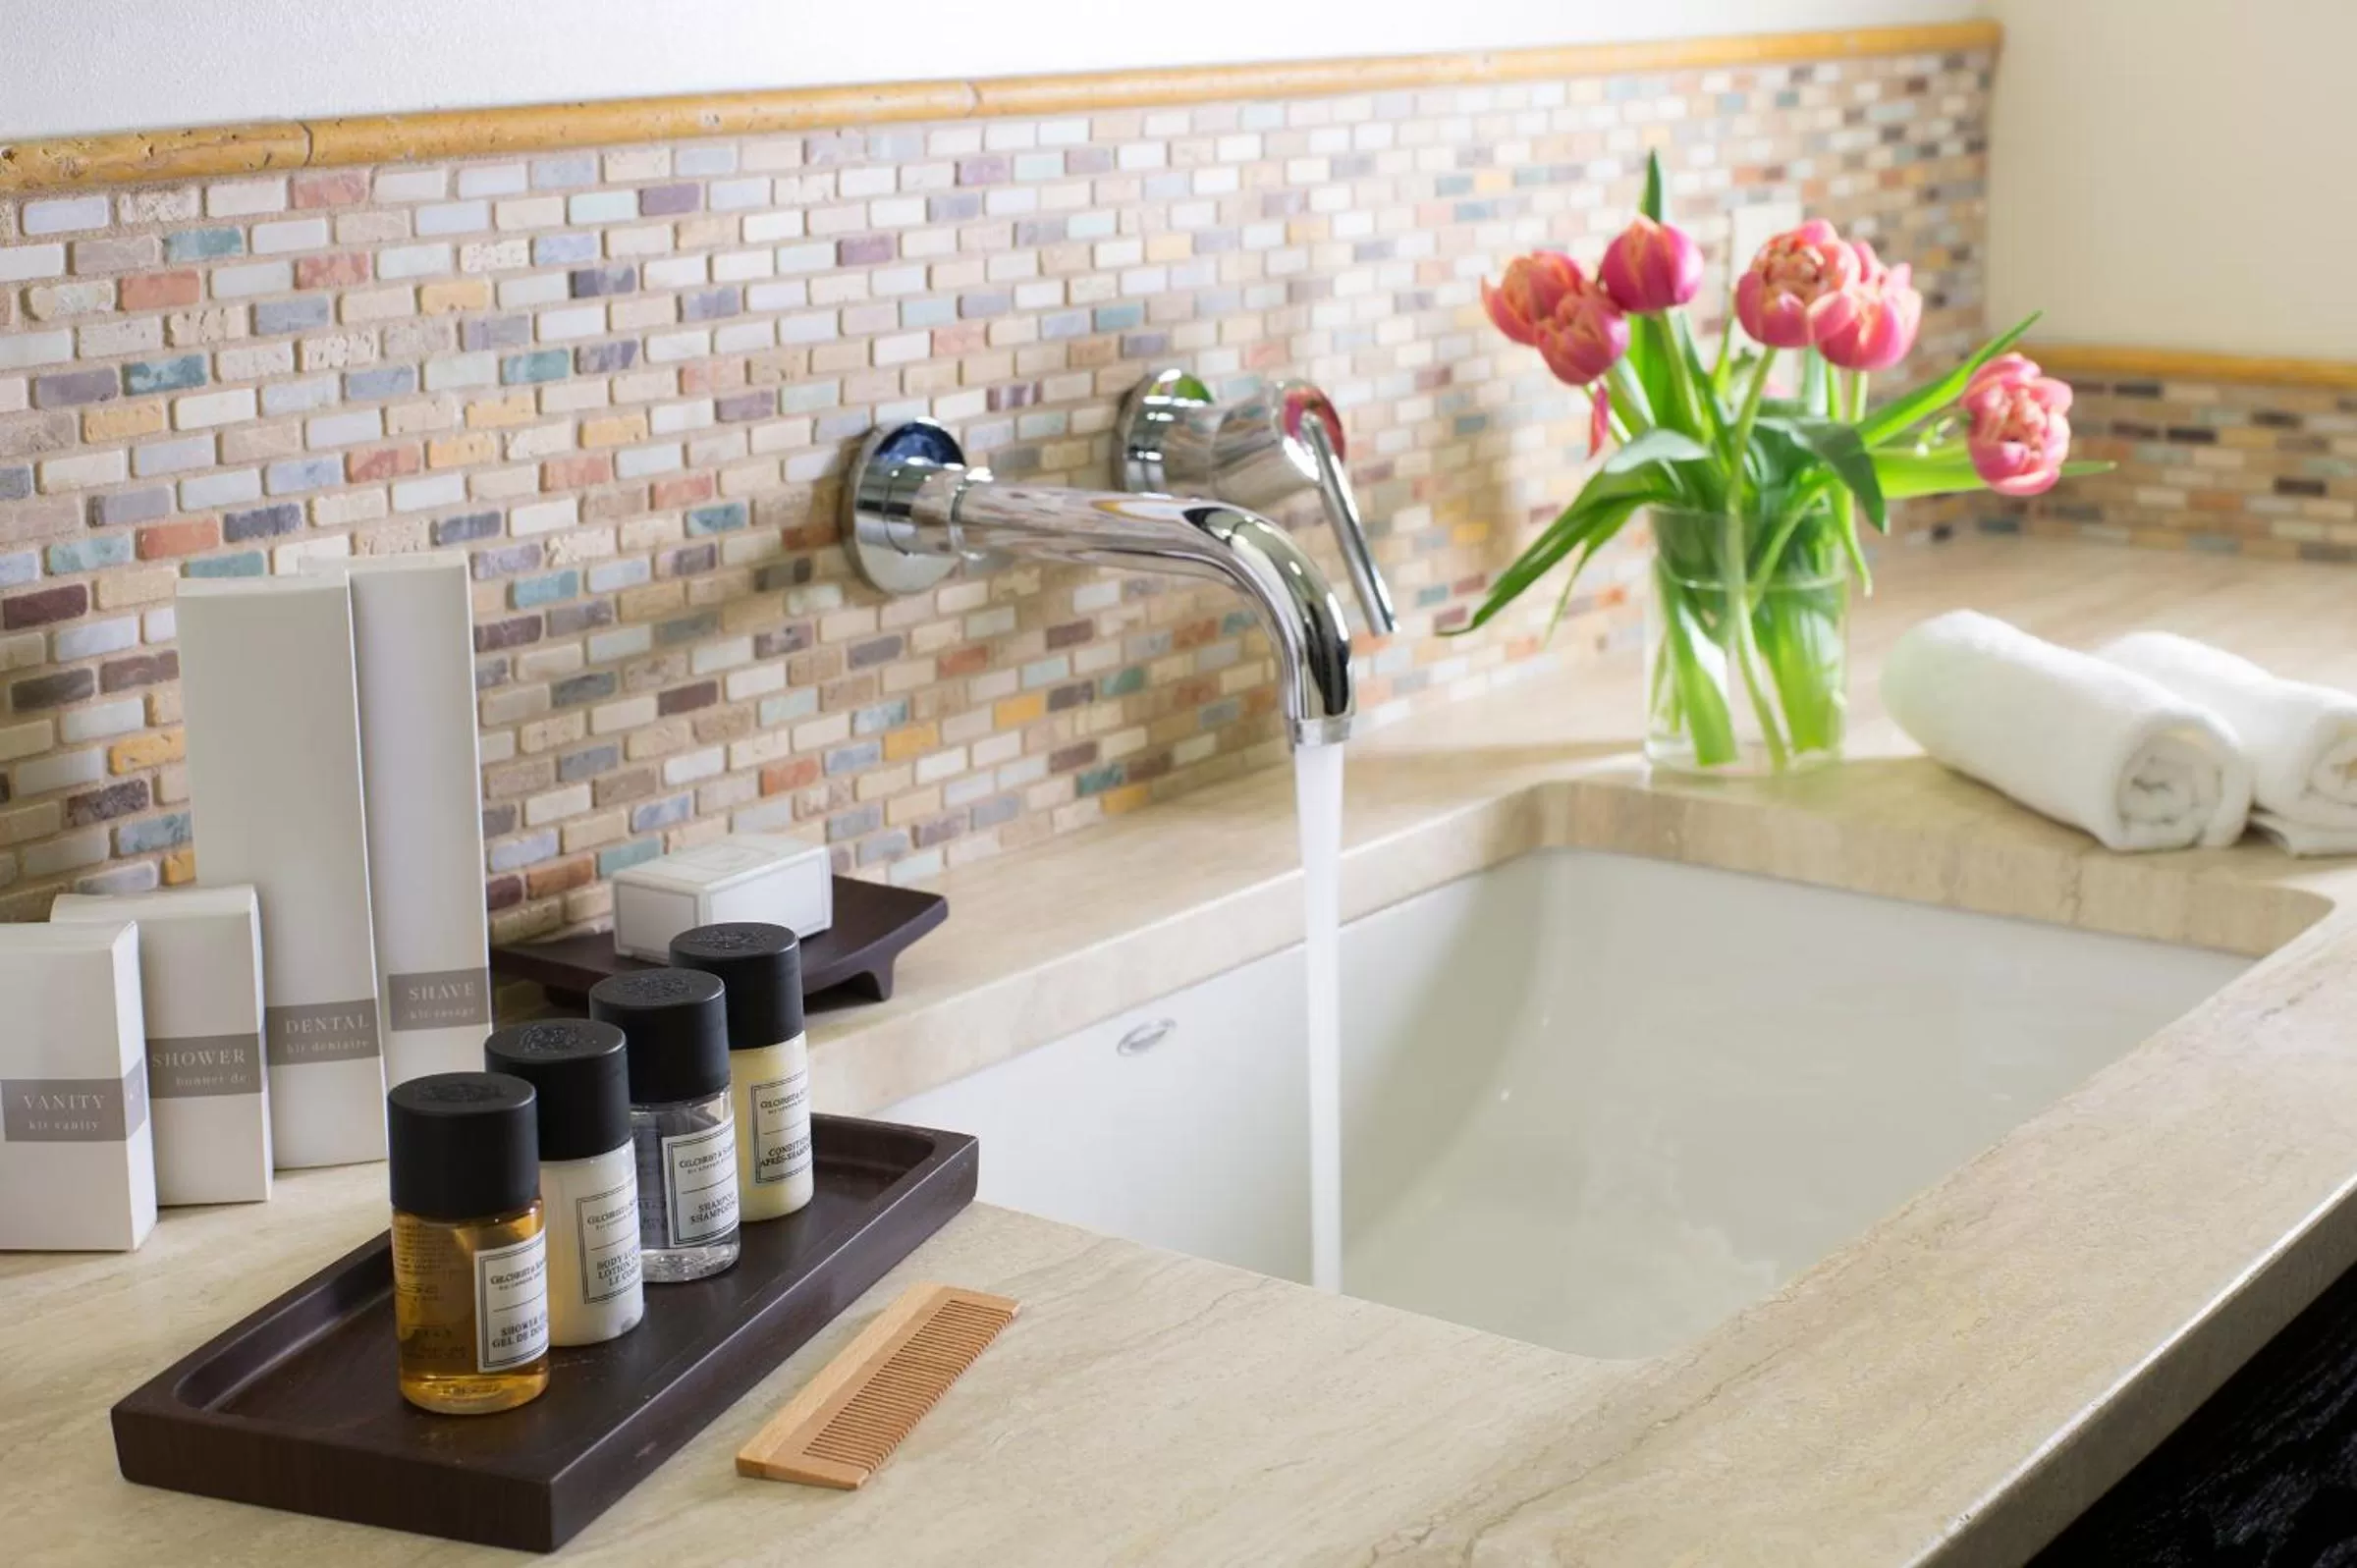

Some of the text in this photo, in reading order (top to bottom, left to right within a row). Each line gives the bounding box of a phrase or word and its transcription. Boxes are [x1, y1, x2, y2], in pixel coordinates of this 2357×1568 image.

[409, 982, 475, 1000] SHAVE
[286, 1013, 369, 1034] DENTAL
[152, 1048, 245, 1068] SHOWER
[24, 1094, 105, 1110] VANITY
